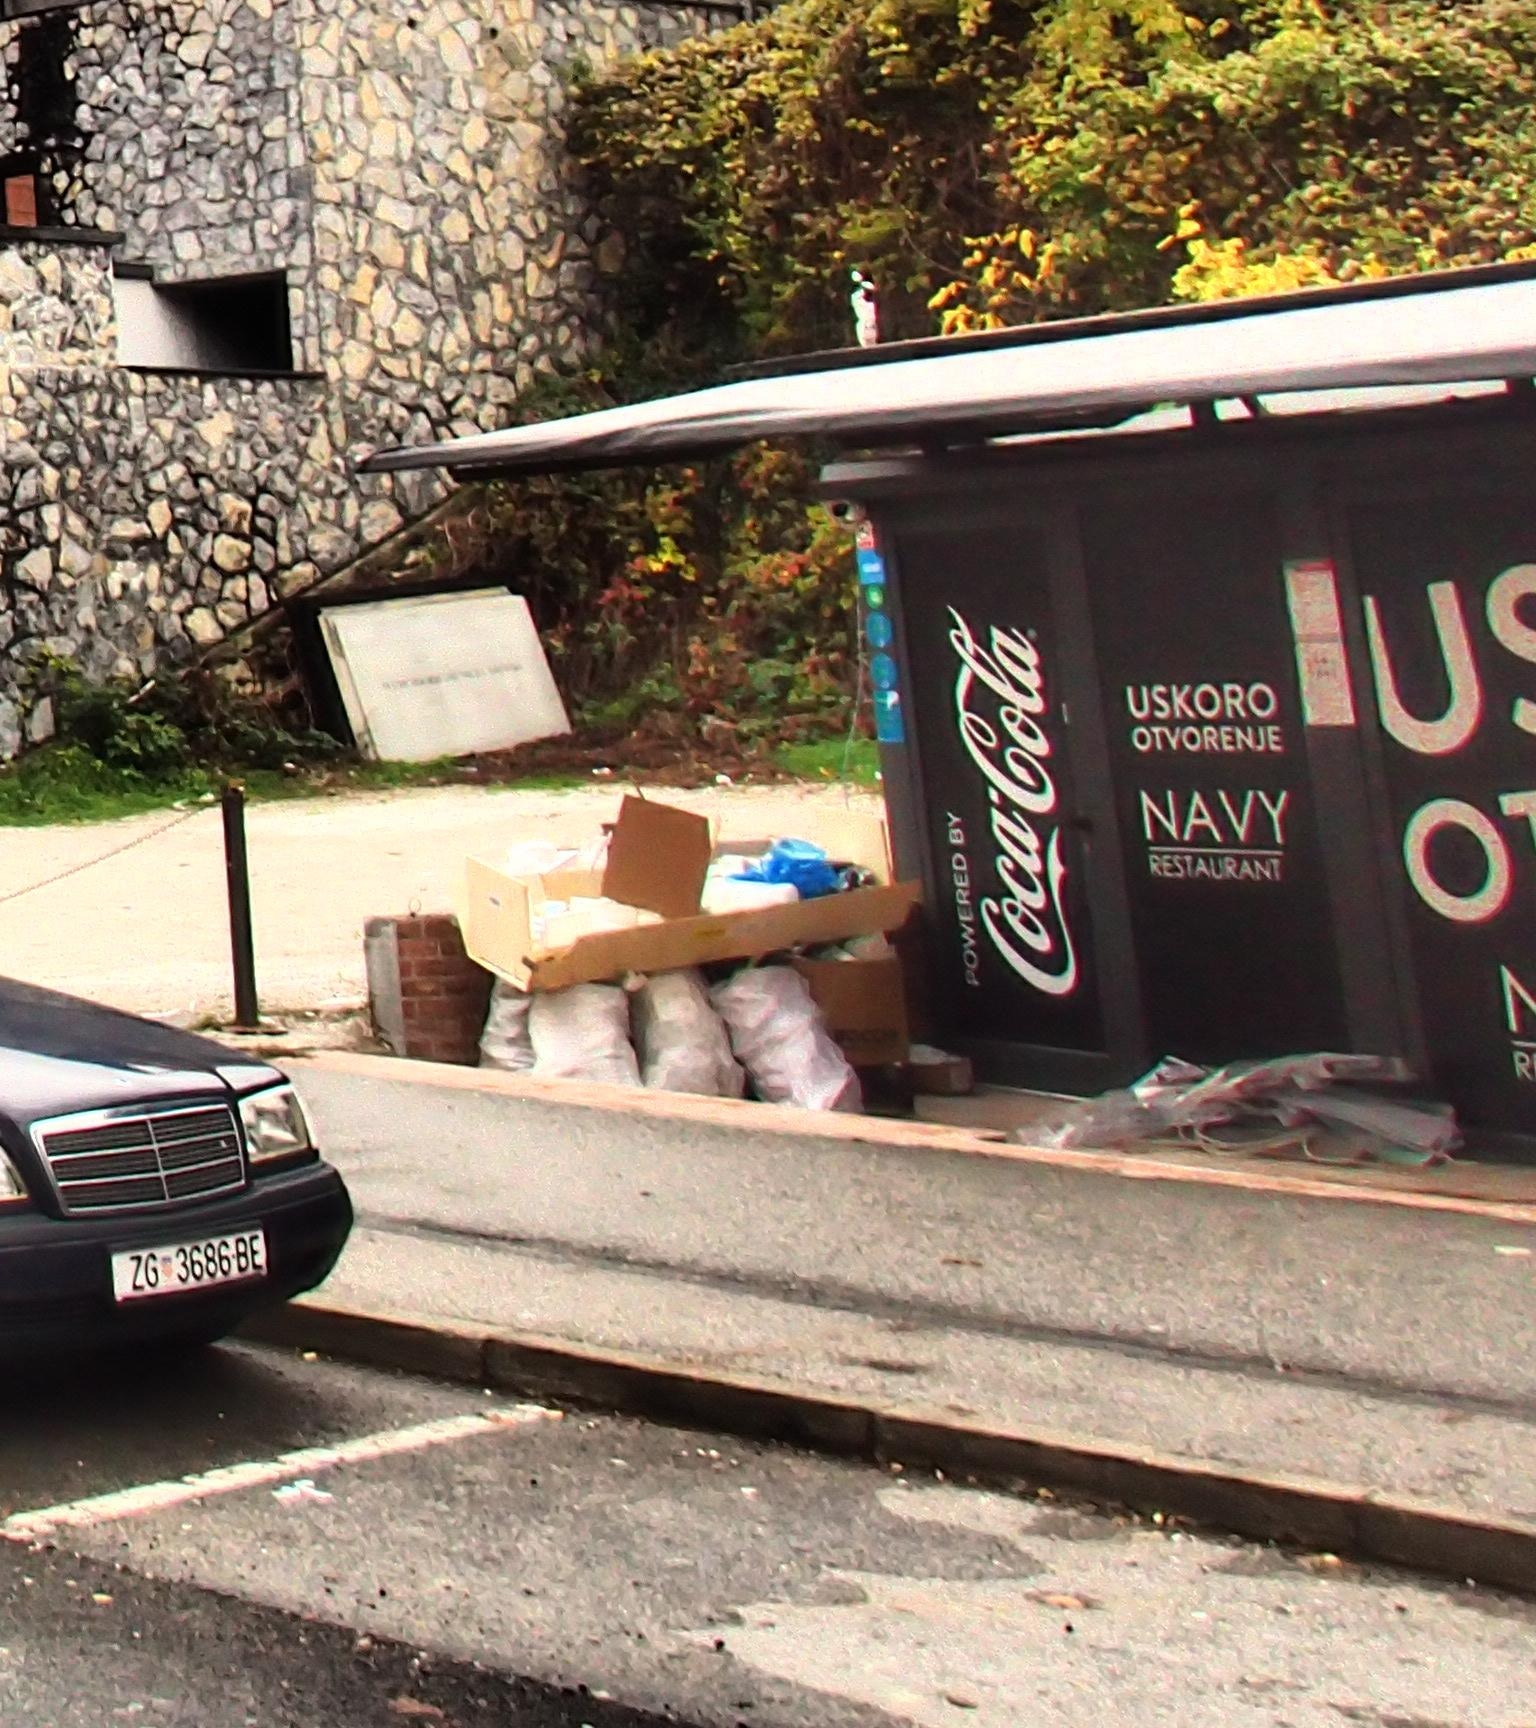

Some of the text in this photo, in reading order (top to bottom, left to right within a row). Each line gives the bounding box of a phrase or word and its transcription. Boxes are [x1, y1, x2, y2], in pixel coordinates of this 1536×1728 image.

[1126, 683, 1278, 719] USKORO
[1132, 725, 1283, 752] OTVORENJE
[946, 605, 1077, 995] Coca-Cola
[1140, 788, 1287, 844] NAVY
[1148, 853, 1282, 881] RESTAURANT
[946, 812, 981, 987] POWERED BY
[130, 1253, 160, 1290] ZG
